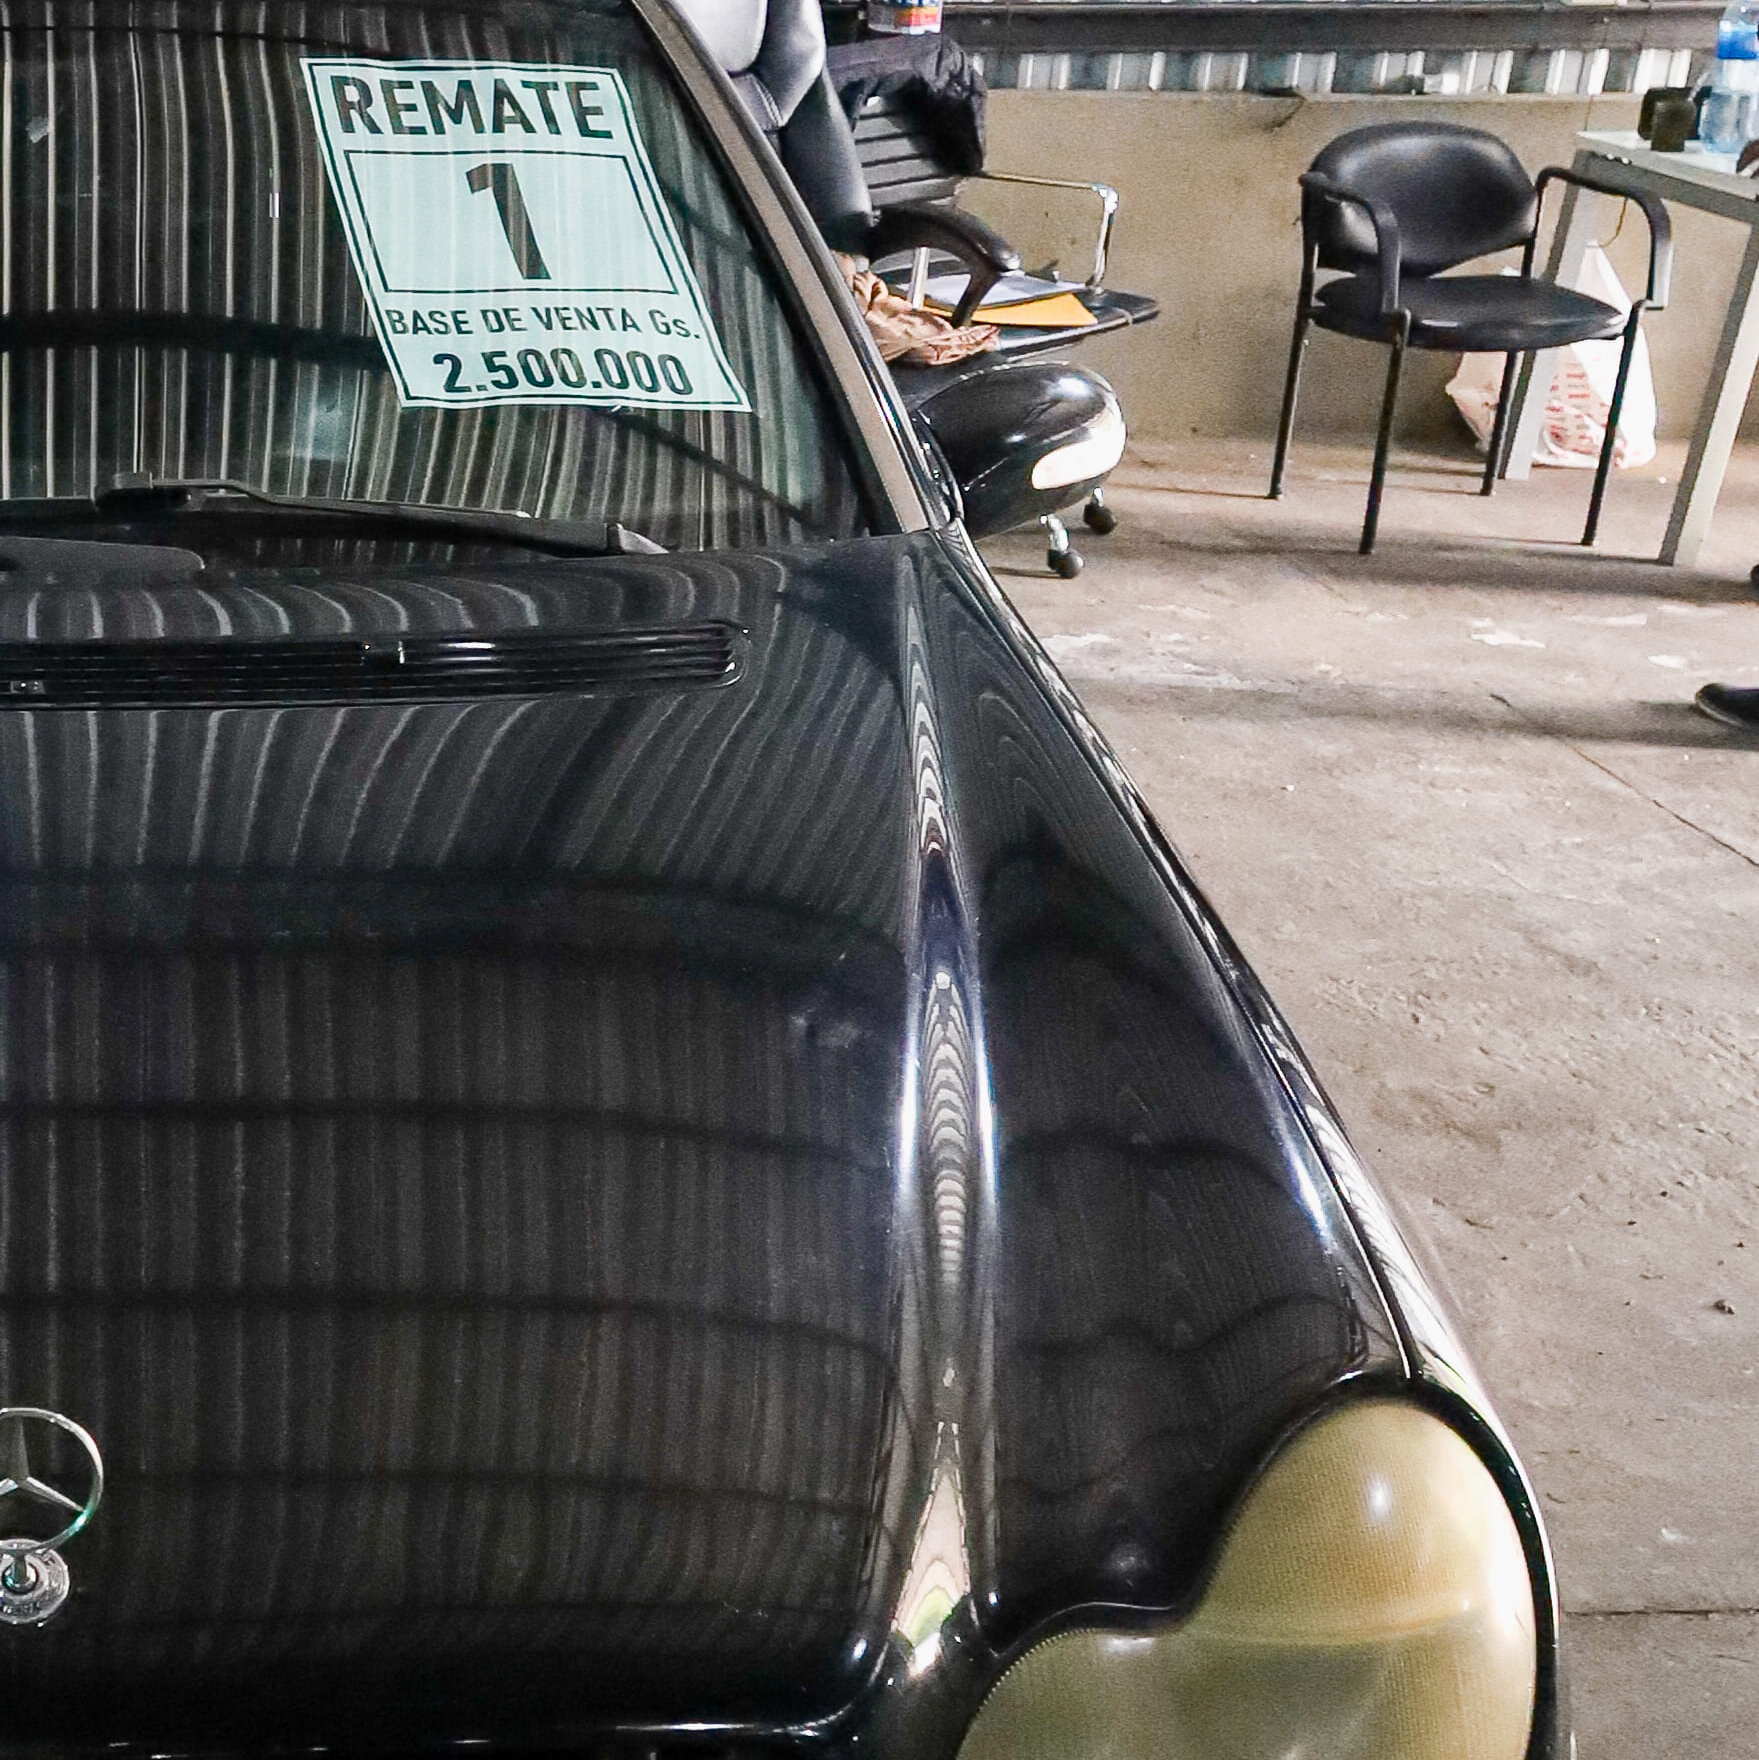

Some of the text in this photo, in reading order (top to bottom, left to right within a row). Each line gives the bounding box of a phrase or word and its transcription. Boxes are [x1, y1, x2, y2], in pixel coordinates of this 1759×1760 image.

[329, 75, 614, 140] REMATE
[465, 162, 552, 280] 1
[385, 306, 701, 340] BASE DE VENTA Gs.
[431, 347, 694, 396] 2.500.000
